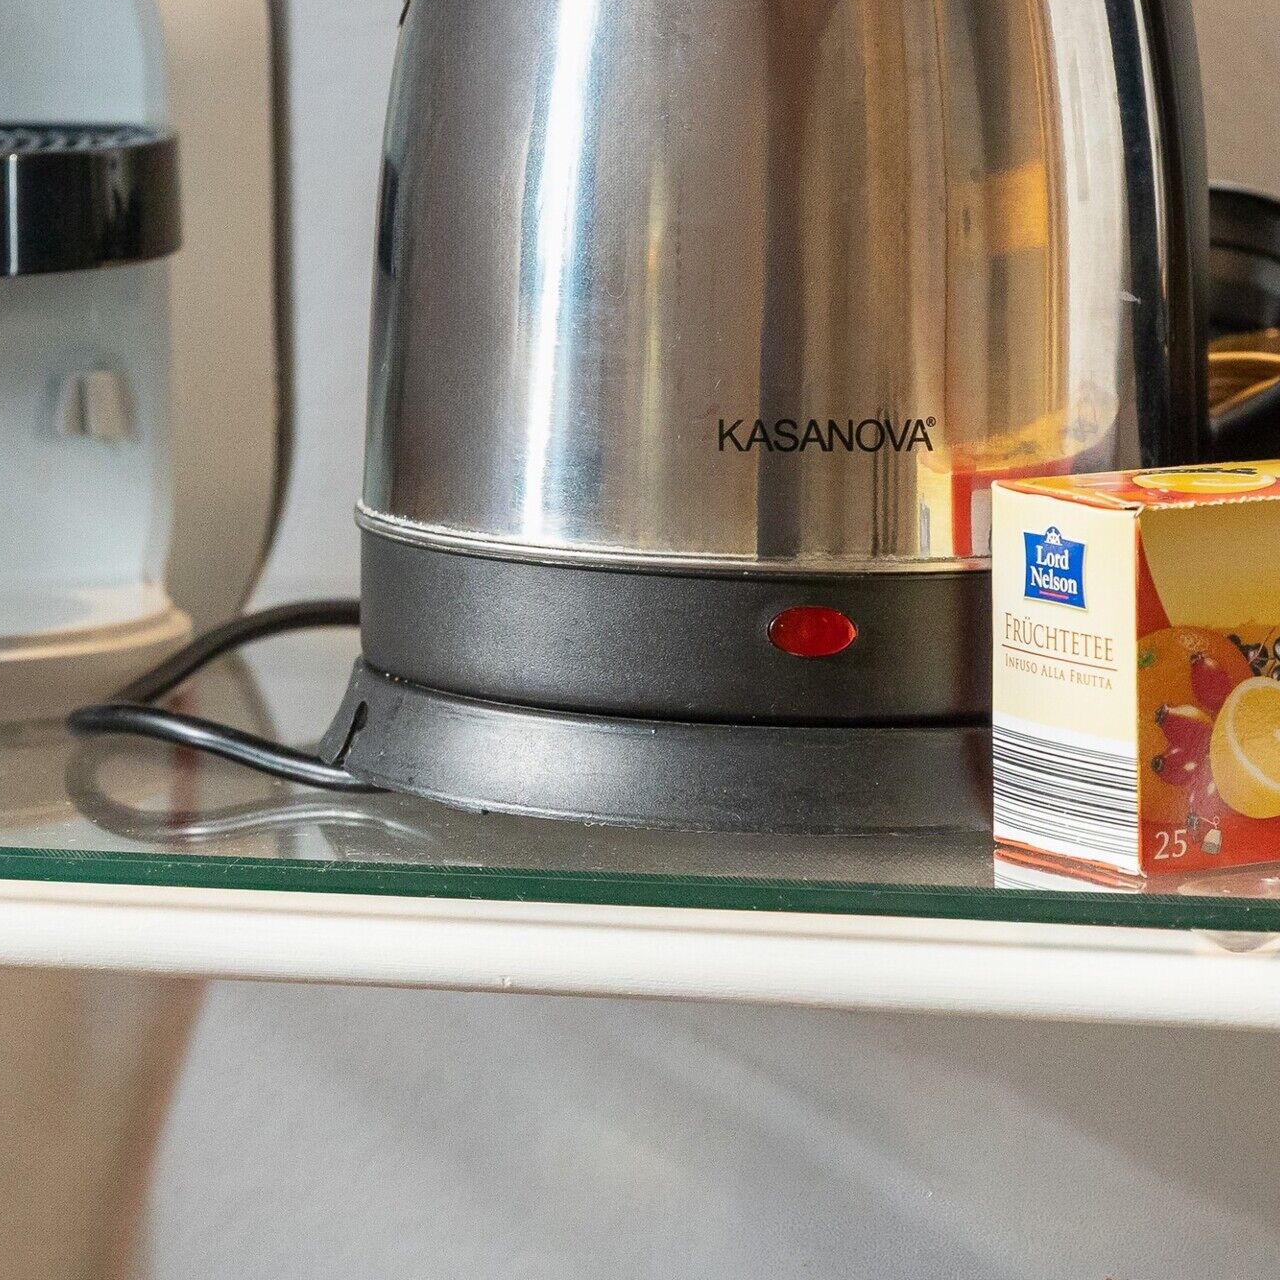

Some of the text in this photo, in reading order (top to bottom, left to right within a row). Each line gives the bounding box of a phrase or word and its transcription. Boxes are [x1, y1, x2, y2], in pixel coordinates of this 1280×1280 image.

[1035, 544, 1070, 570] Lord
[1030, 566, 1078, 595] Nelson
[1005, 611, 1114, 662] FRÜCHTETEE
[1005, 653, 1113, 690] INFUSO ALLA FRUTTA
[1153, 829, 1188, 860] 25
